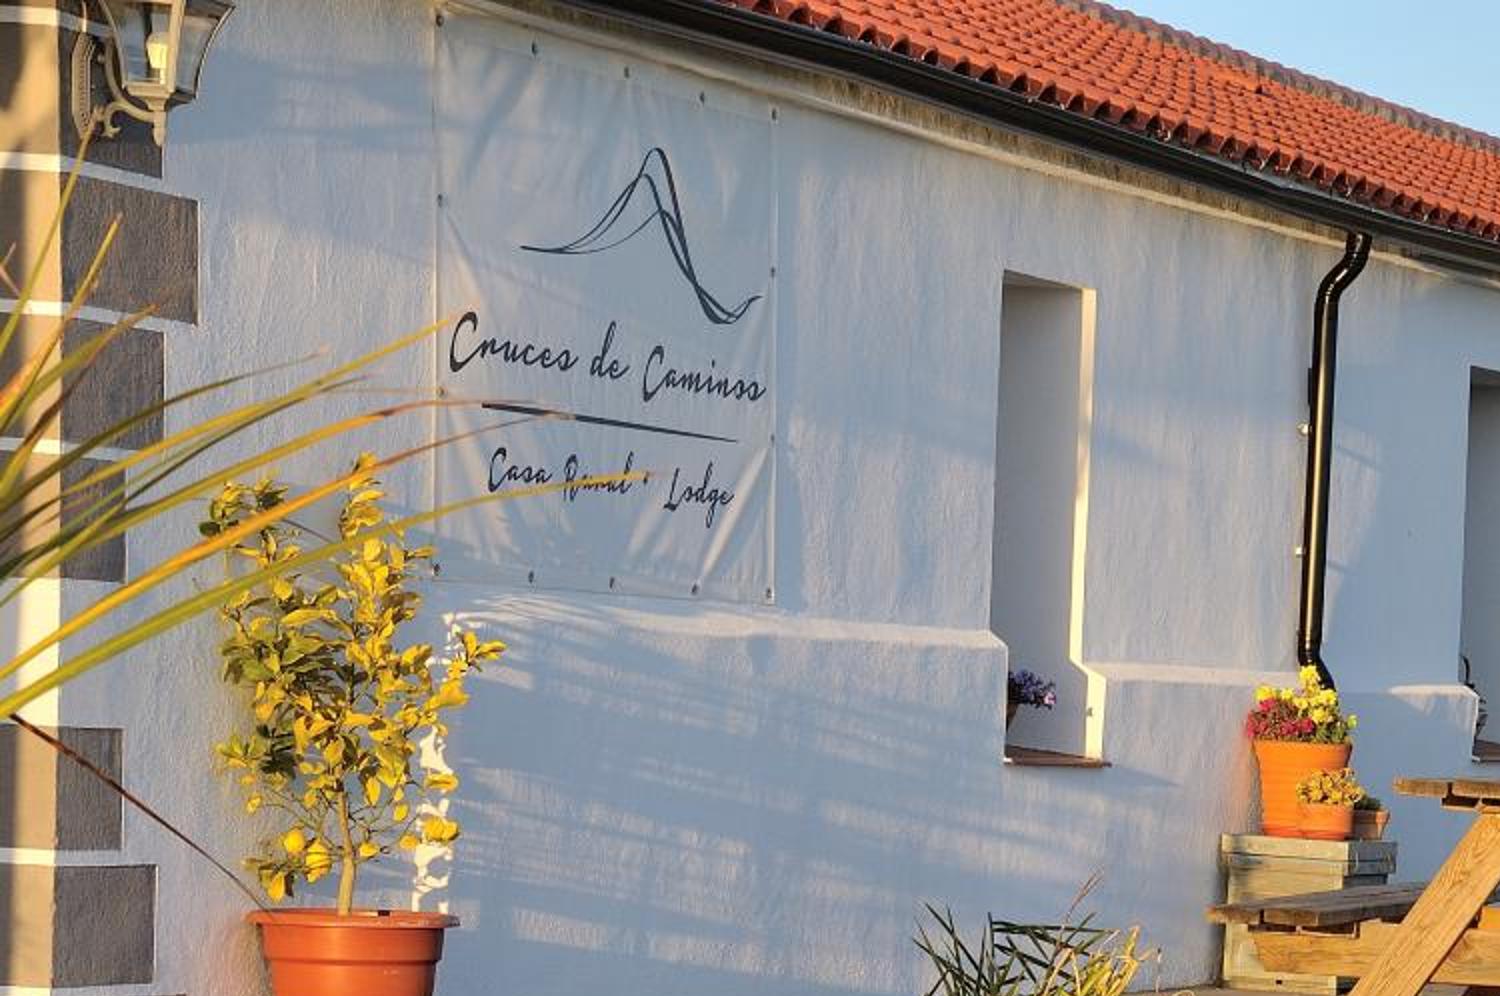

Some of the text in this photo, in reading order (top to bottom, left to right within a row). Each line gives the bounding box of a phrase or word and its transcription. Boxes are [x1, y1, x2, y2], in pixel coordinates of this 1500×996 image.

[449, 311, 767, 402] Cruces de Caminos
[487, 447, 553, 493] Casa
[663, 461, 735, 529] Lodge
